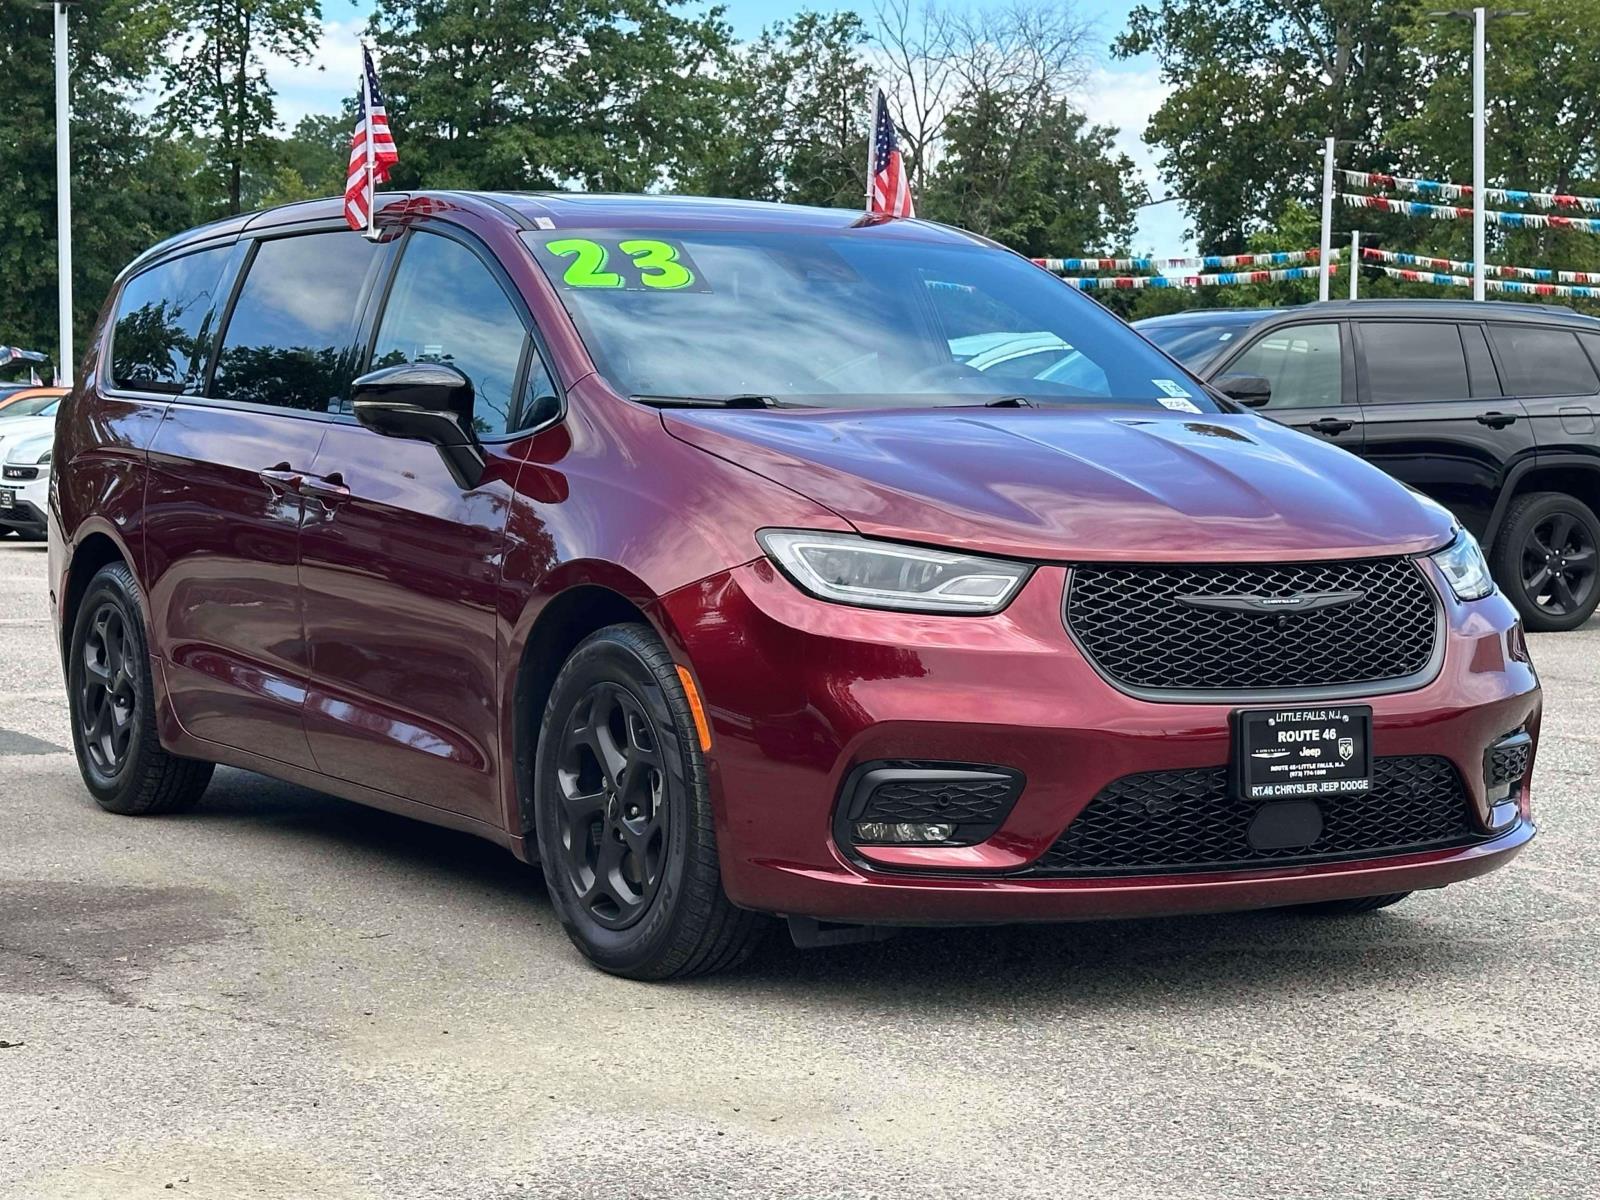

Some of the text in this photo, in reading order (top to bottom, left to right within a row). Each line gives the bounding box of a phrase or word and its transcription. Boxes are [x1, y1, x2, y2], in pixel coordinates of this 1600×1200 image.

[544, 239, 695, 289] 23
[1276, 710, 1342, 723] LITTLE FALLS, N.J.
[1277, 728, 1337, 743] ROUTE 46
[1299, 746, 1321, 758] Jeep
[1274, 783, 1319, 795] CHRYSLER
[1319, 781, 1339, 792] JEEP
[1340, 780, 1369, 791] DODGE
